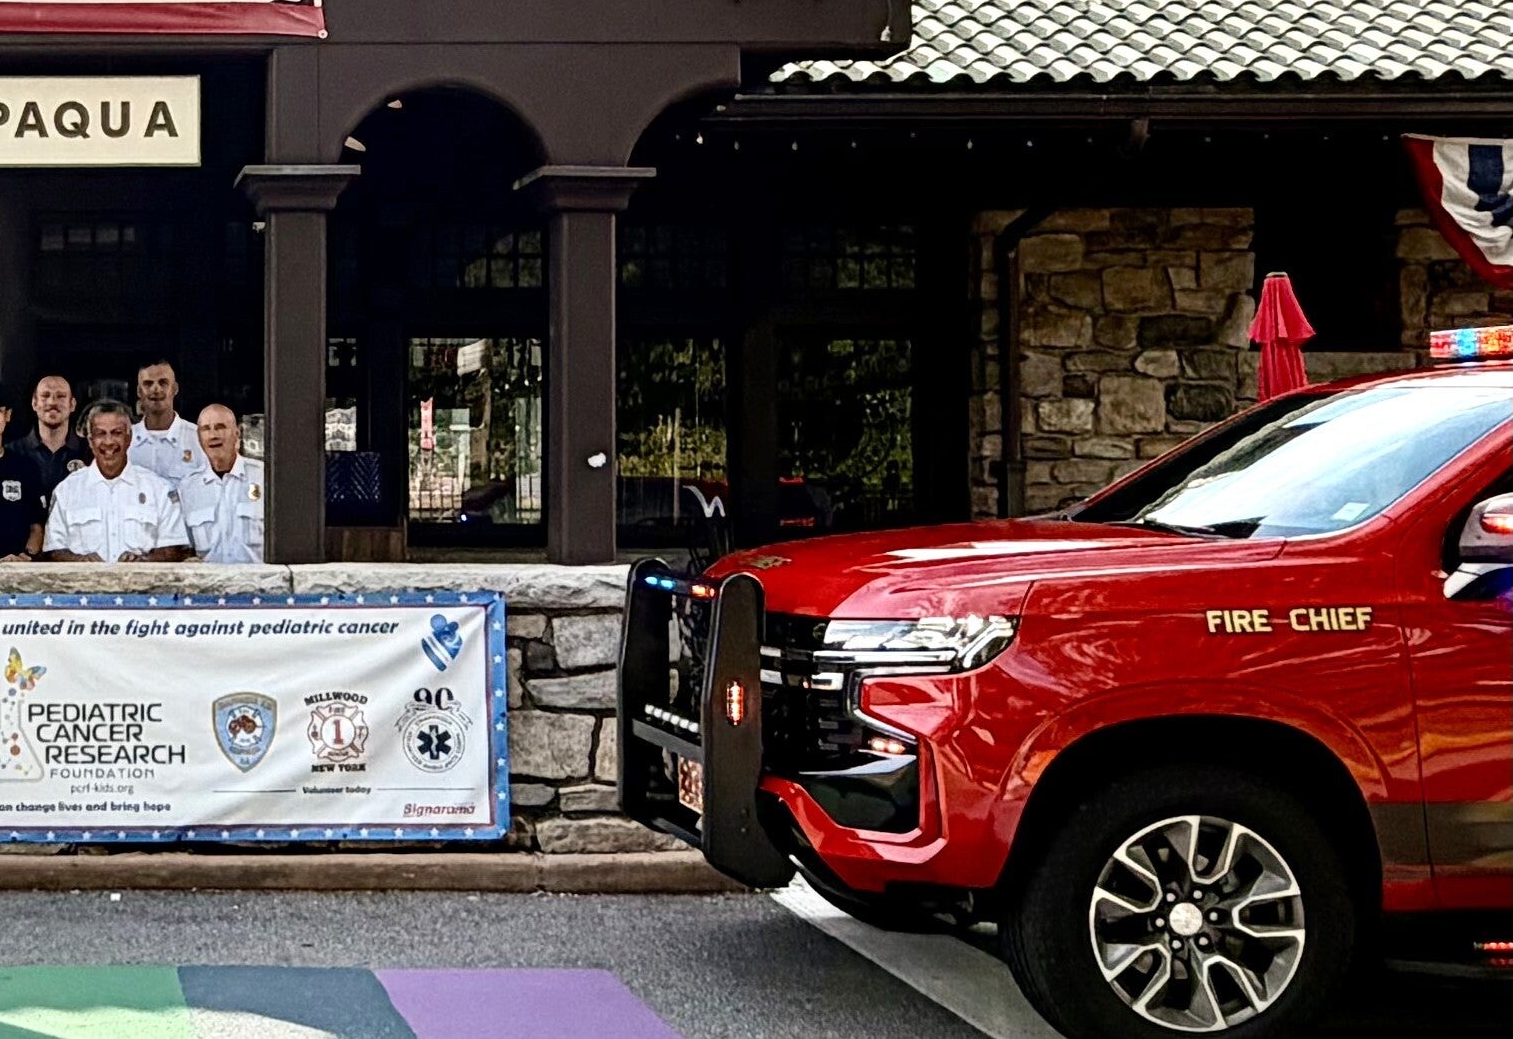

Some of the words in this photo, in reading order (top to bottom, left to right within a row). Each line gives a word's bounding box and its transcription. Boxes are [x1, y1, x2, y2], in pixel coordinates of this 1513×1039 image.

[1206, 609, 1273, 633] FIRE
[1289, 606, 1373, 631] CHIEF
[2, 619, 64, 635] united
[67, 619, 85, 635] in
[90, 619, 120, 635] the
[125, 619, 171, 638] fight
[175, 619, 244, 638] against
[248, 619, 333, 638] pediatric
[337, 621, 399, 635] cancer
[304, 691, 368, 706] MILLWOOD
[28, 703, 162, 722] PEDIATRIC
[36, 723, 143, 743] CANCER
[332, 719, 344, 745] 1
[45, 744, 186, 764] RESEARCH
[50, 768, 154, 779] FOUNDATION
[311, 764, 335, 773] NEW
[338, 763, 366, 772] YORK
[70, 782, 134, 795] pcrf-kids.org
[302, 786, 343, 794] Volunteer
[345, 786, 371, 794] today
[16, 801, 56, 813] change
[58, 801, 82, 811] lives
[86, 801, 107, 811] and
[111, 801, 140, 813] bring
[143, 801, 171, 813] hope
[403, 803, 476, 816] Signarama
